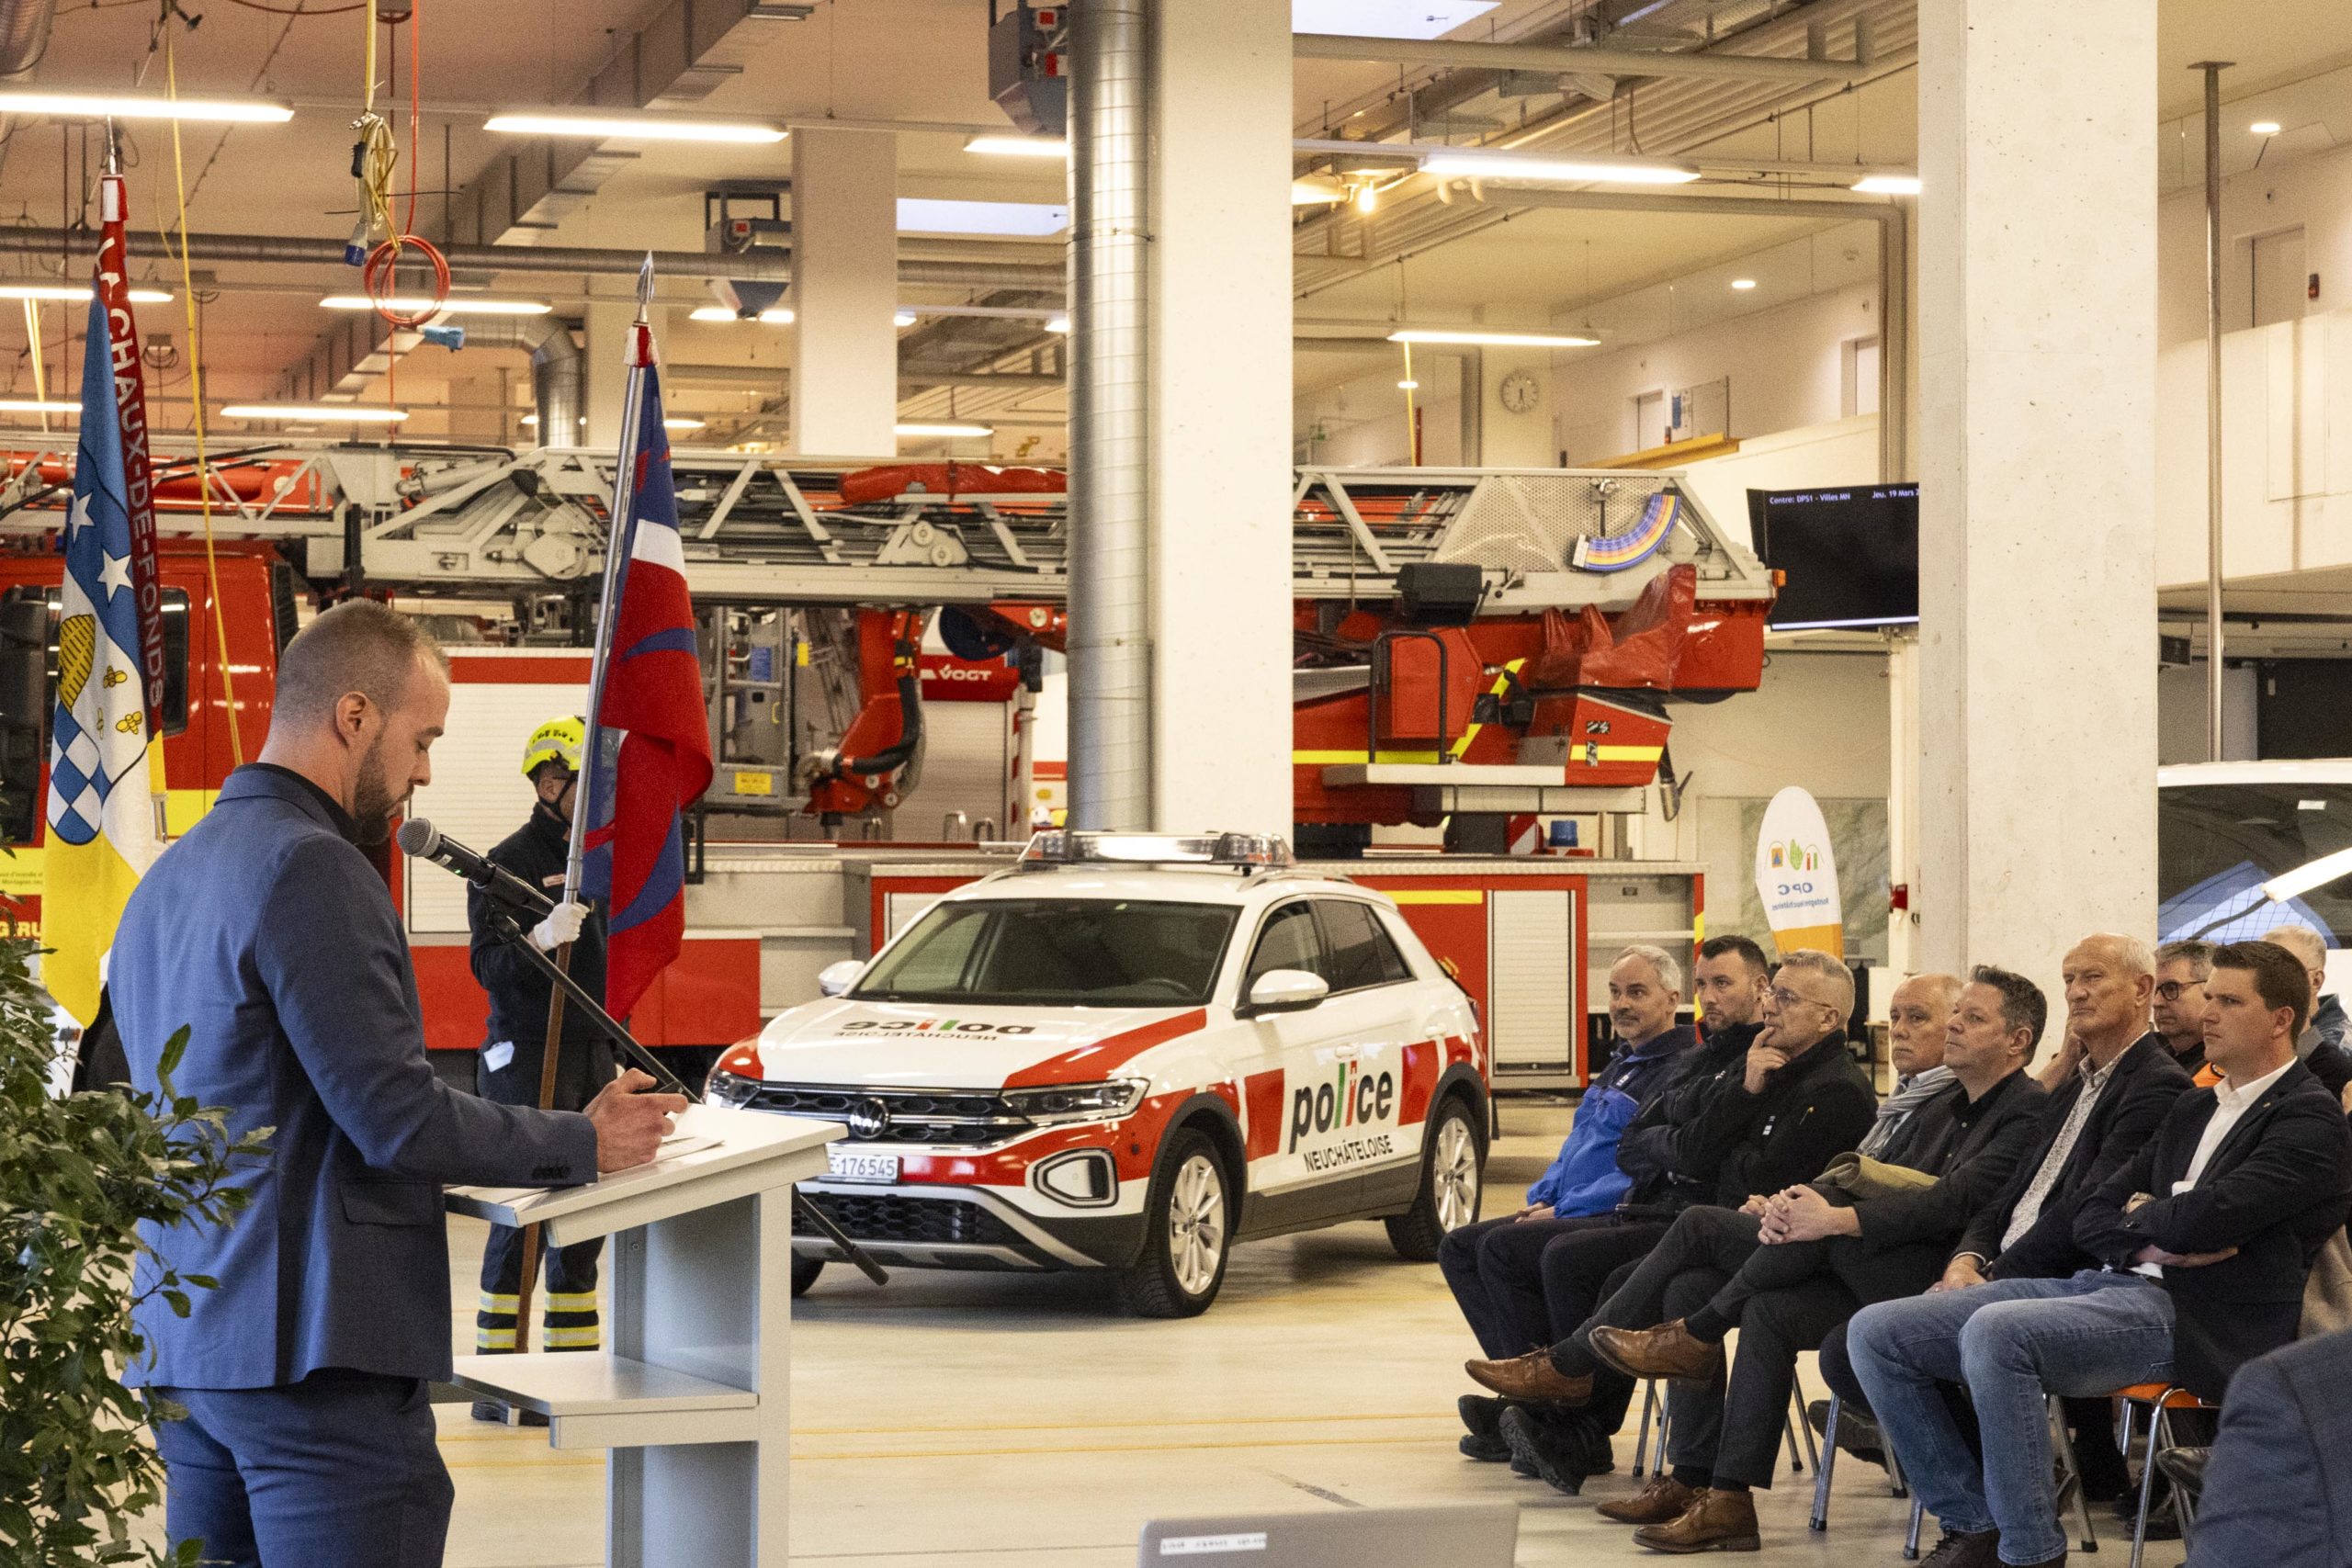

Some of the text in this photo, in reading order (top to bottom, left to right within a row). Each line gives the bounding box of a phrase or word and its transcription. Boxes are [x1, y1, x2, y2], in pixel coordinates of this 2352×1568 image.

[108, 308, 164, 707] CHAUX-DE-FONDS
[1770, 496, 1795, 504] Centre:
[1819, 492, 1838, 502] Villes
[1871, 491, 1886, 499] Jeu.
[1898, 489, 1915, 497] Mars
[938, 663, 992, 681] VOGT
[1288, 1060, 1393, 1155] police
